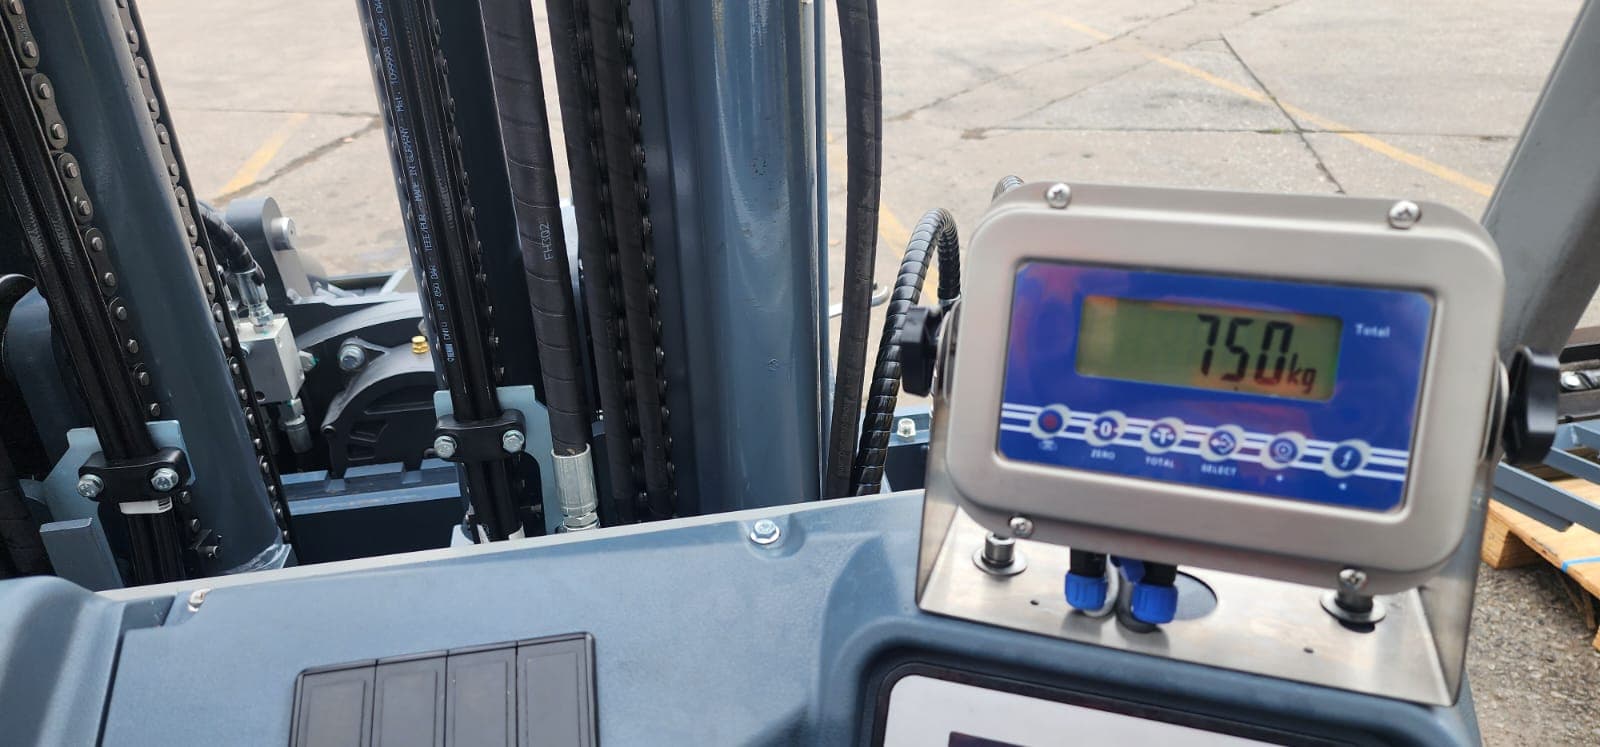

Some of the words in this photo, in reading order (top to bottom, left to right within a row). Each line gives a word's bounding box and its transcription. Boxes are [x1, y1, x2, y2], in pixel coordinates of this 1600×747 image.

[1354, 323, 1391, 338] Total
[1090, 450, 1116, 461] ZERO
[1144, 456, 1175, 469] TOTAL
[1200, 463, 1237, 477] SELECT
